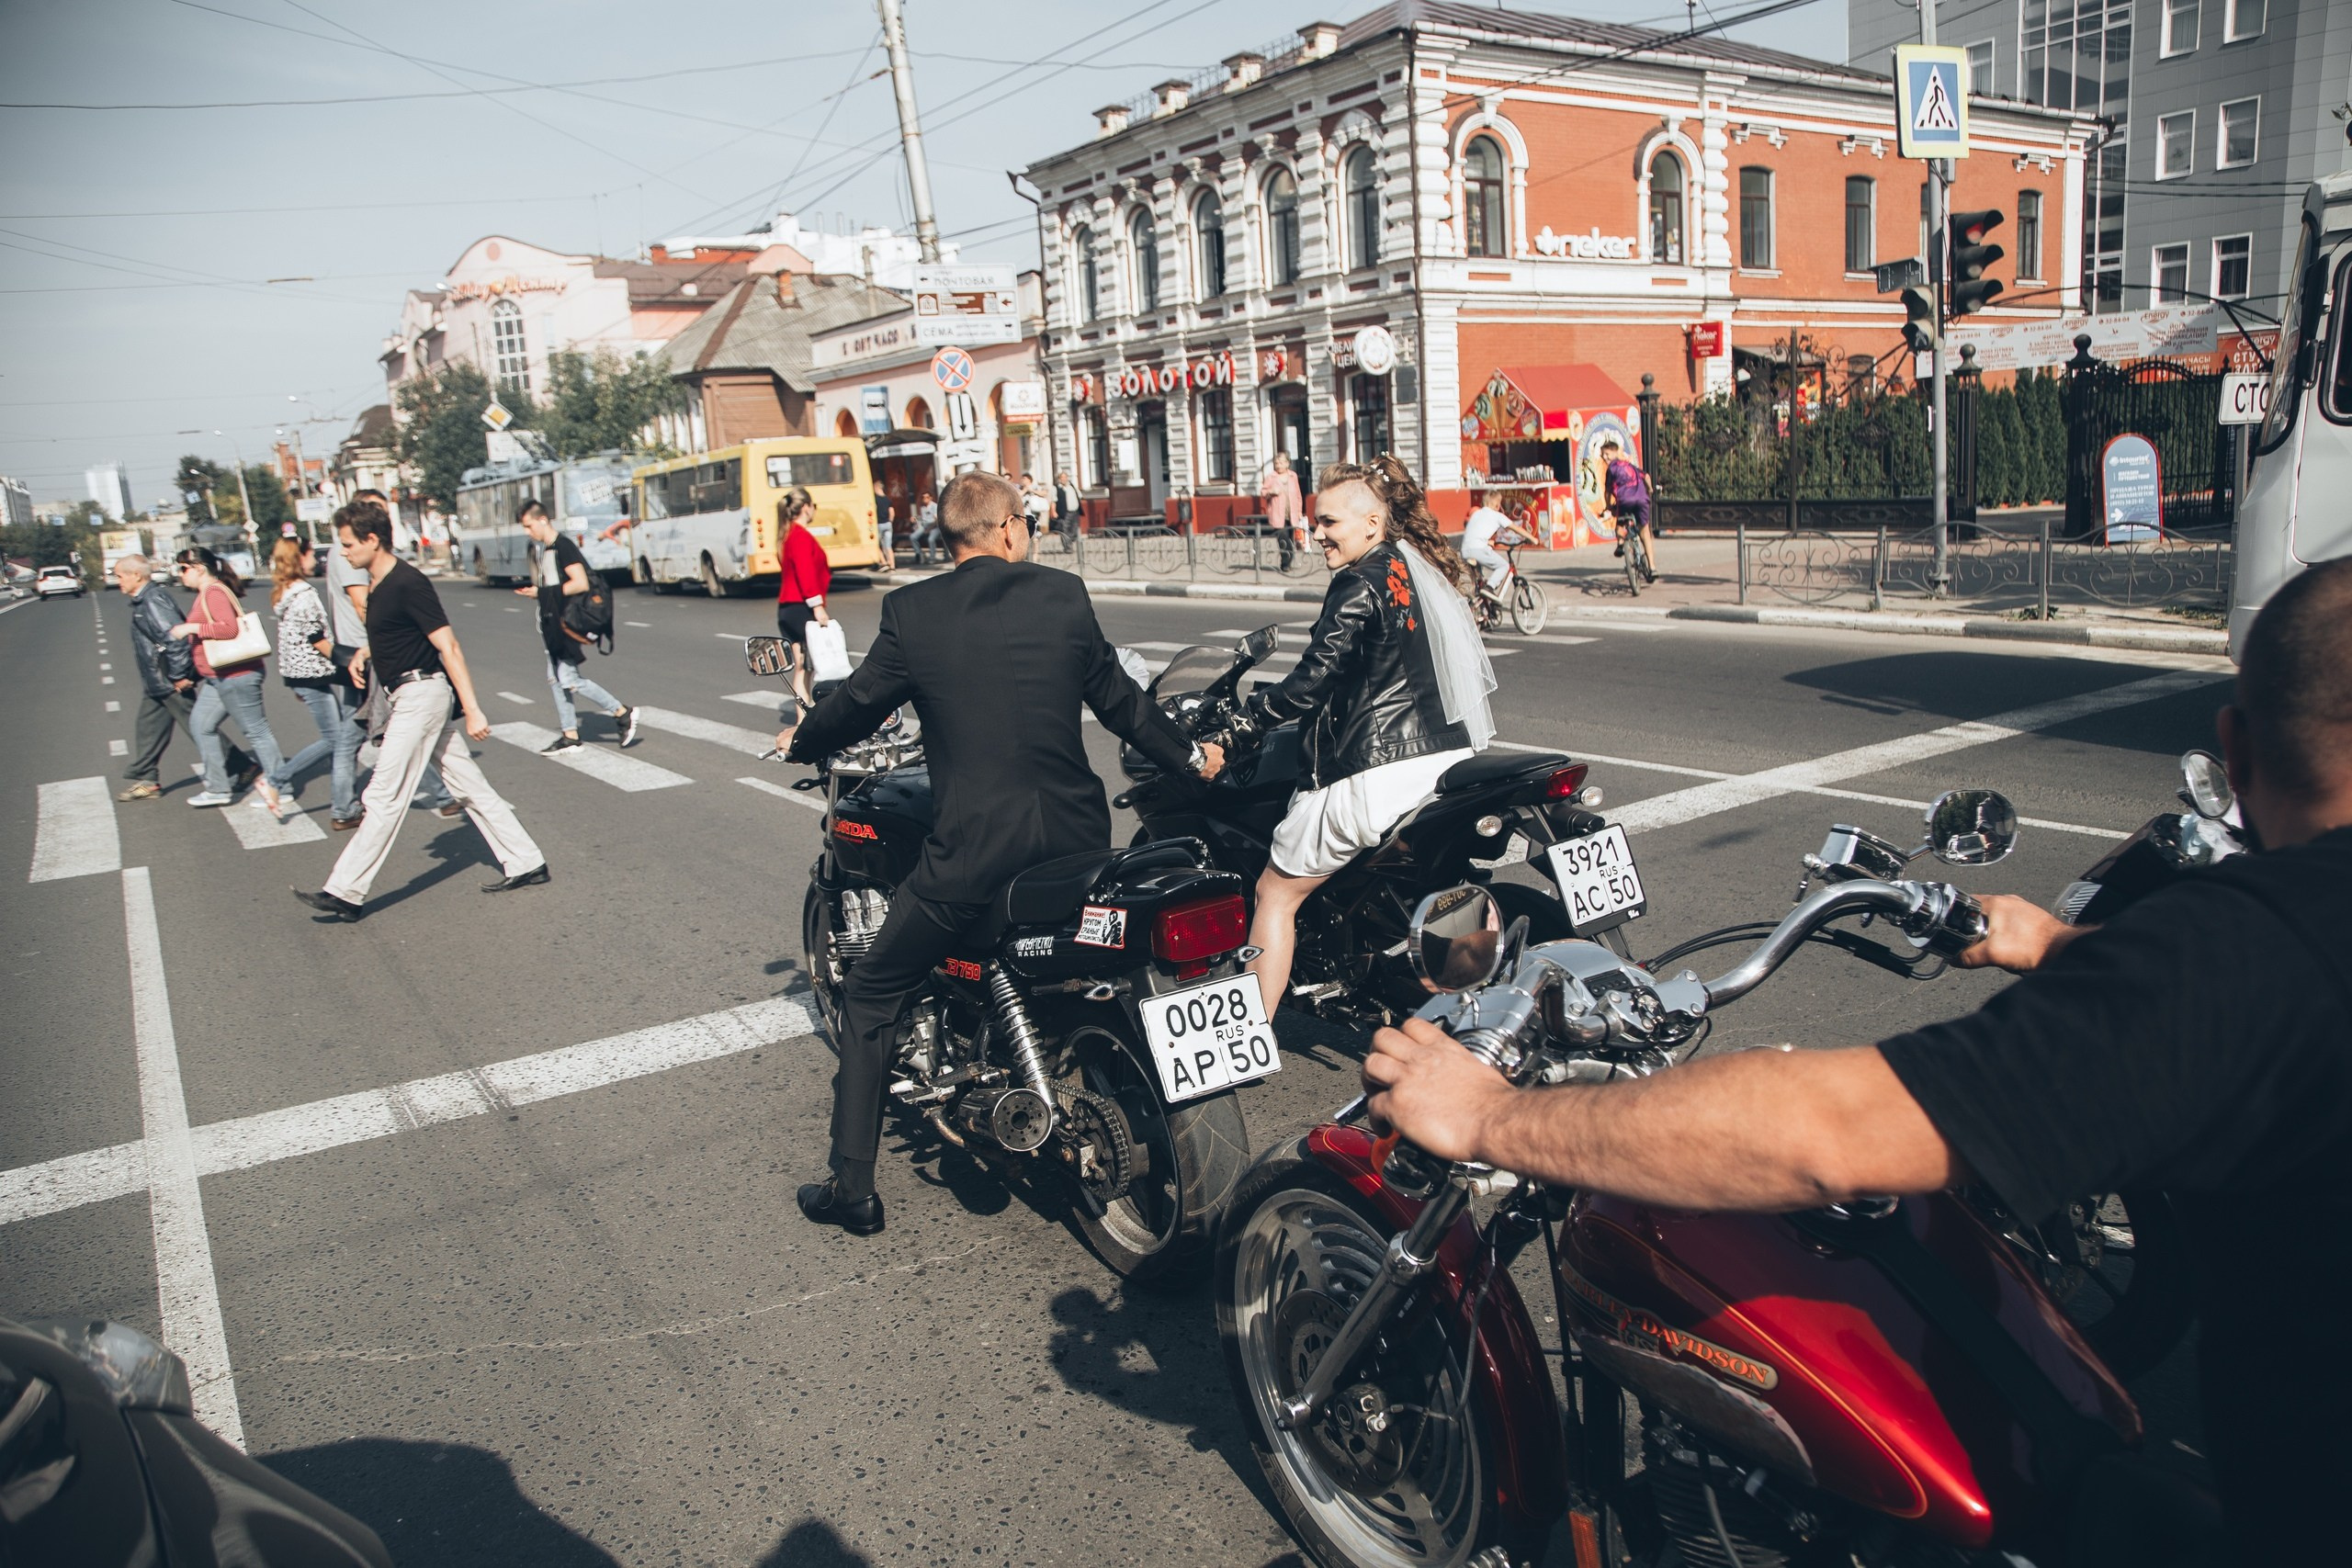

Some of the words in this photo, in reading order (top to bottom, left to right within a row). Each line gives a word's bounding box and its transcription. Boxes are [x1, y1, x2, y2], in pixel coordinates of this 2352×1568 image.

[1559, 227, 1636, 258] rieker
[933, 276, 995, 287] ПОЧТОВАЯ
[2242, 334, 2276, 346] Eergy
[1105, 350, 1235, 398] ЗОЛОТОЙ
[1338, 353, 1357, 368] ЦЕН
[2234, 382, 2270, 413] СТО
[1562, 836, 1619, 875] 3921
[1600, 865, 1618, 879] RUS
[1574, 886, 1605, 919] АС
[1609, 874, 1636, 905] 50
[1017, 949, 1053, 957] RACING
[1165, 988, 1248, 1038] 0028
[1216, 1025, 1244, 1042] RUS
[1173, 1050, 1216, 1092] АР
[1227, 1035, 1271, 1073] 50
